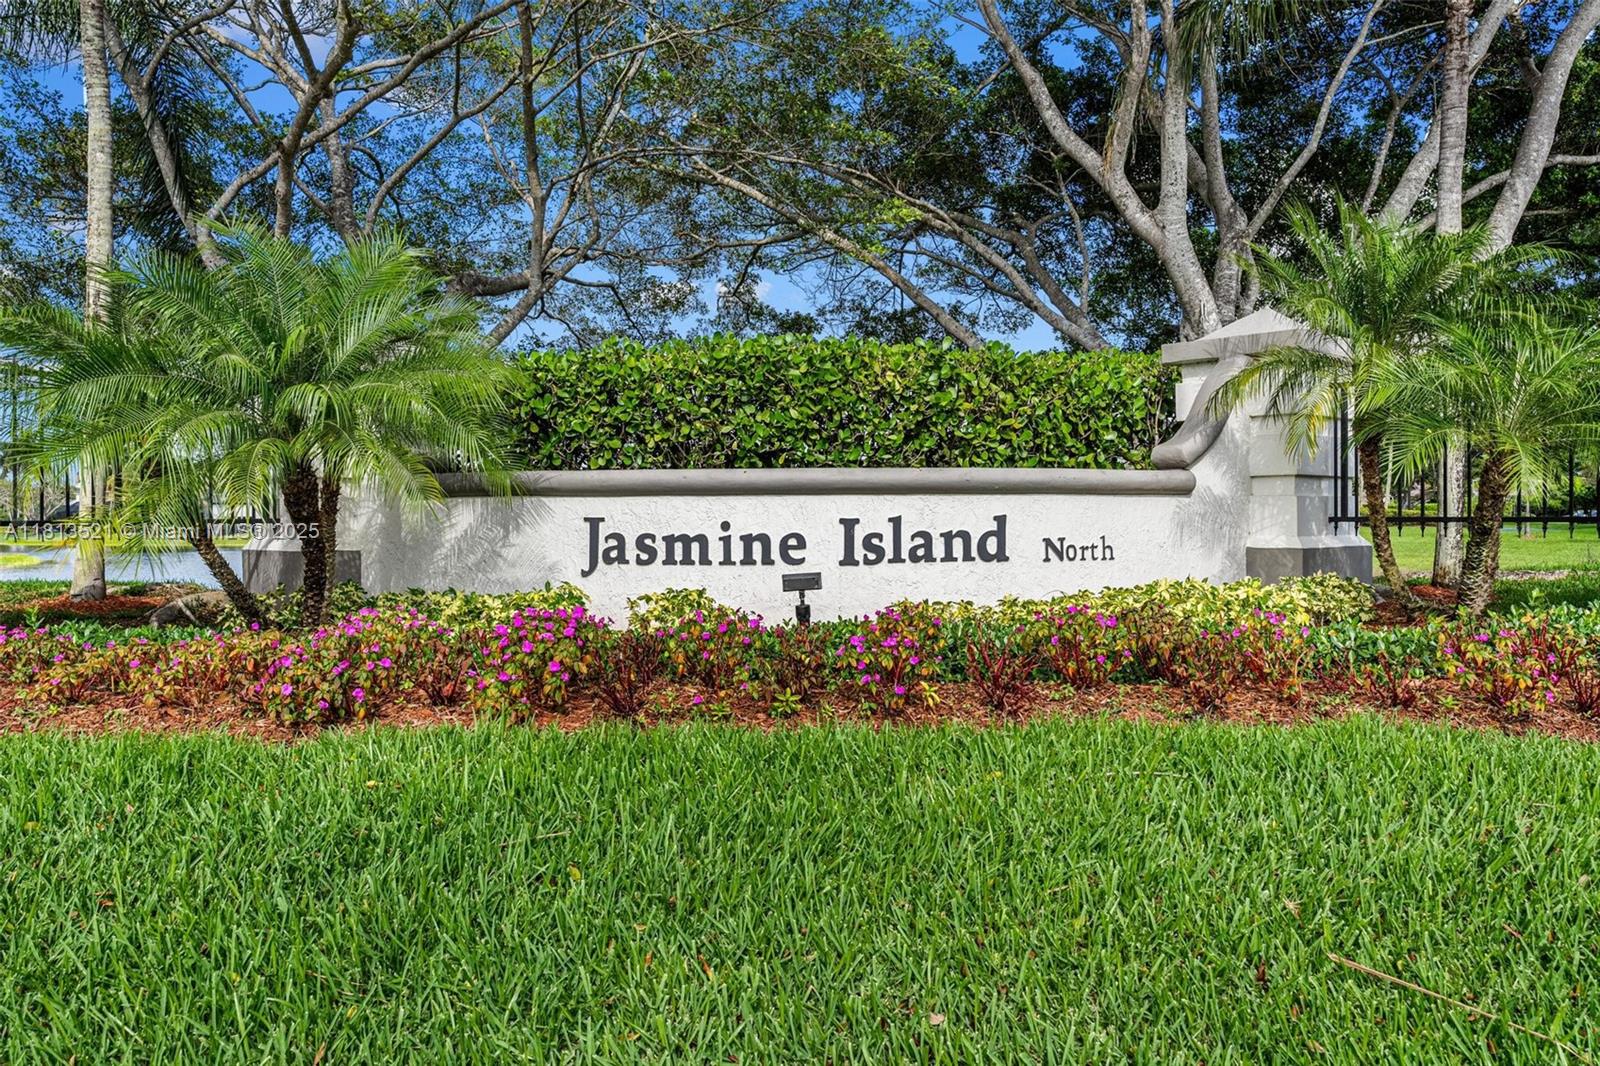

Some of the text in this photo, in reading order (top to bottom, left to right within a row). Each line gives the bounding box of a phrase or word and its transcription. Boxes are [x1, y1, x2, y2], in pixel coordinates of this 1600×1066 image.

[581, 515, 1115, 577] Jasmine Island North
